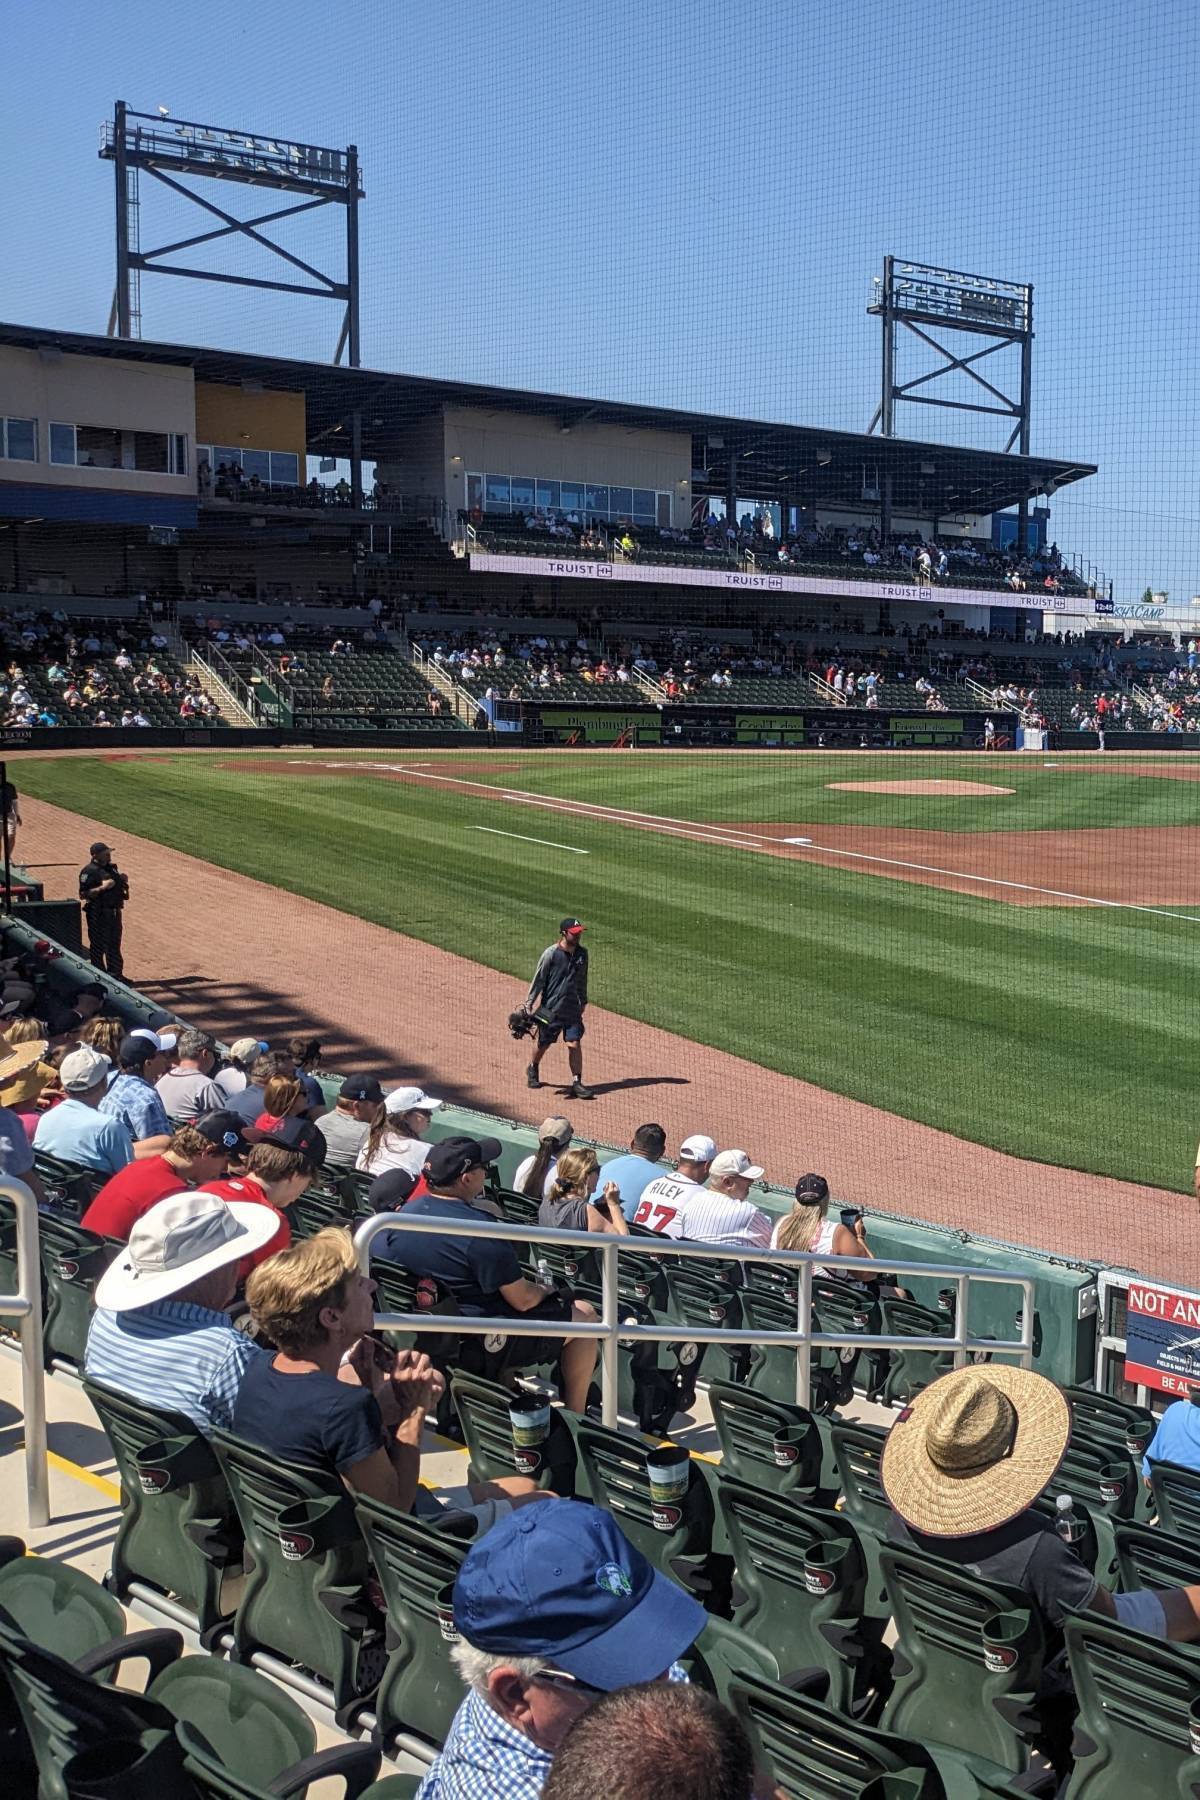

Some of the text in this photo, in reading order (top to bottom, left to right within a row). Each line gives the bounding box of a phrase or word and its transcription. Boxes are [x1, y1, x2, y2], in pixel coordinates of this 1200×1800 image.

[548, 563, 594, 574] TRUIST
[725, 575, 766, 586] TRUIST
[881, 586, 917, 597] TRUIST
[1020, 597, 1052, 607] TRUIST
[1095, 603, 1114, 612] 12:45
[1134, 605, 1165, 619] CAMP
[649, 1182, 685, 1200] RILEY
[633, 1201, 678, 1232] 27
[1129, 1287, 1169, 1315] NOT
[1156, 1360, 1170, 1369] FIELD
[1161, 1375, 1176, 1390] BE
